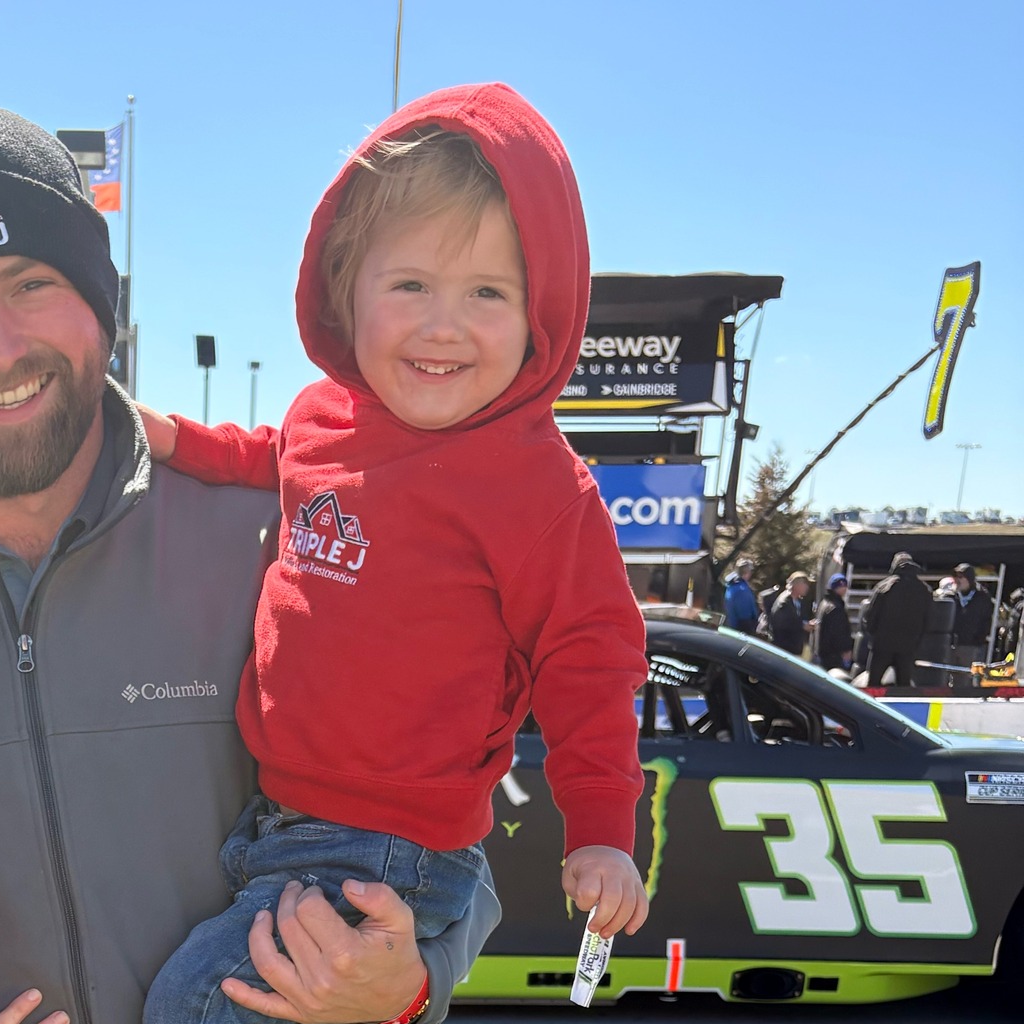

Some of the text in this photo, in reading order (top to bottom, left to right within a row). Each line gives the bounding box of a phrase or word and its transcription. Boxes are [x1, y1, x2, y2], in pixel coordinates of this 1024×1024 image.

[613, 383, 677, 396] GAINBRIDGE
[287, 527, 346, 565] TRIPLE
[346, 548, 366, 571] J
[307, 561, 357, 586] Restoration
[141, 680, 218, 700] Columbia
[709, 776, 978, 938] 35
[583, 932, 603, 974] choPark
